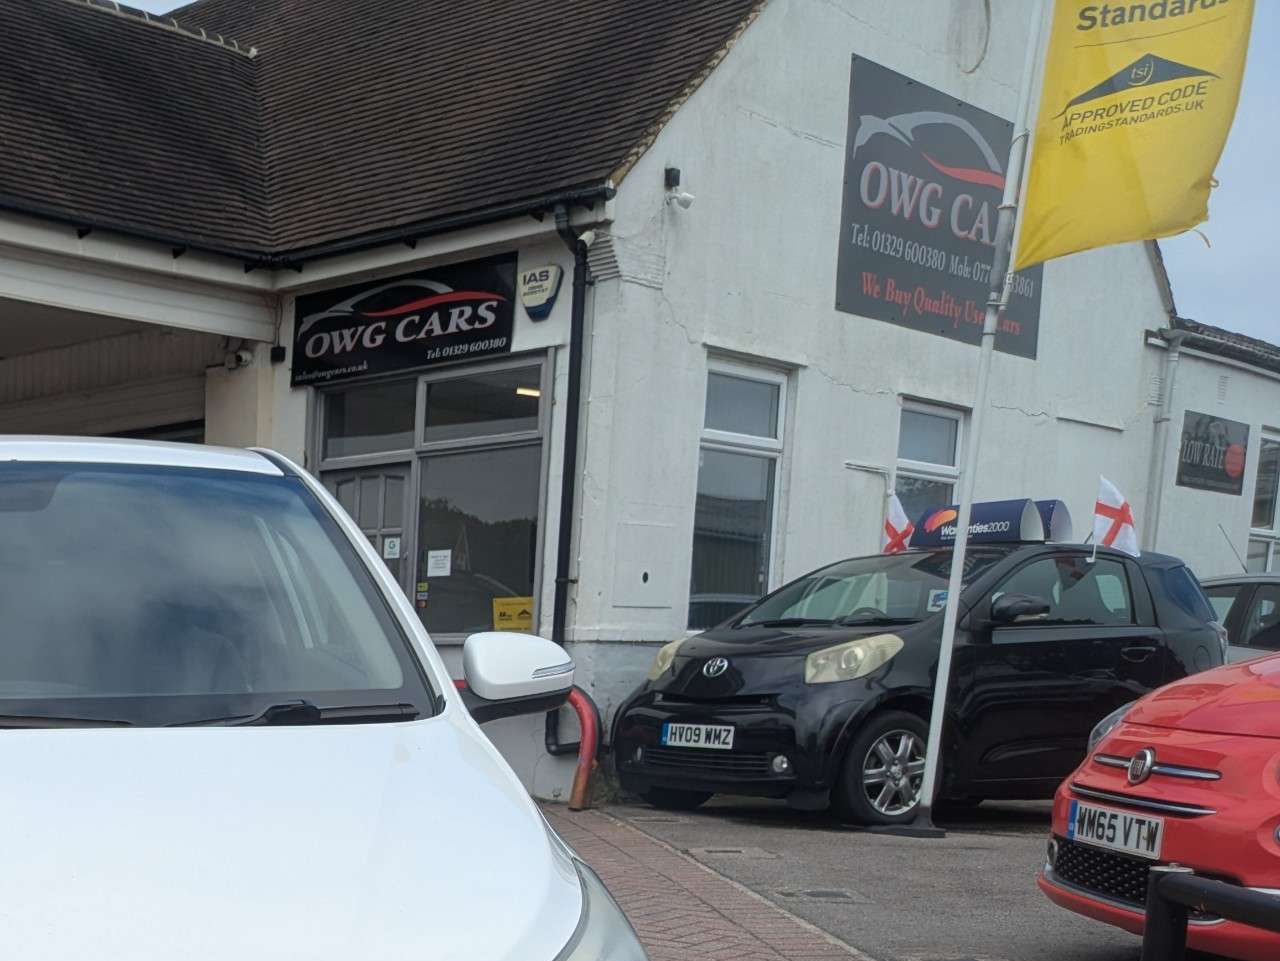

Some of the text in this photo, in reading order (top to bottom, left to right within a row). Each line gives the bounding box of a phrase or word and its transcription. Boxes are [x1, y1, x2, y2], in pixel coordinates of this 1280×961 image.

[1059, 99, 1204, 145] TRADINGSTANDARDS.UK
[1062, 80, 1209, 132] APPROVED CODE
[860, 161, 943, 228] OWG
[851, 223, 870, 249] Tel:
[872, 229, 904, 258] 01329
[904, 240, 946, 272] 600380
[522, 270, 549, 285] IAS
[862, 271, 1024, 336] We Buy Quality Use ars
[305, 300, 498, 359] OWG CARS
[426, 337, 507, 359] Tel: 01329 600380
[669, 725, 732, 746] HV09 WMZ
[1076, 806, 1160, 852] WM65 VTW
